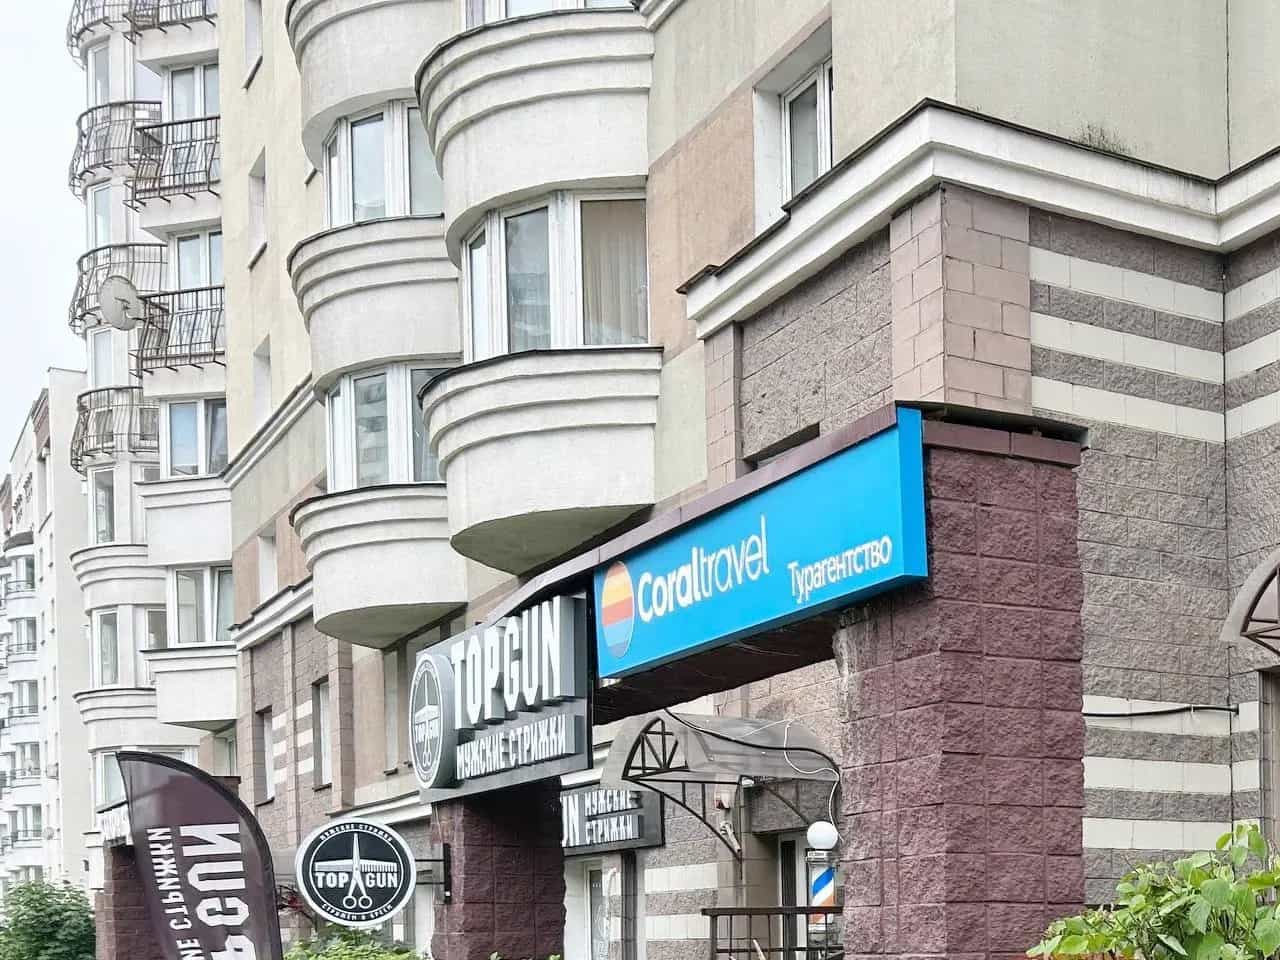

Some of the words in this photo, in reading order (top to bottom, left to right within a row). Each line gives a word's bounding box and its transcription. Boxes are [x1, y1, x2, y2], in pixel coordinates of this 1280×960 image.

[787, 535, 893, 604] Турагентство
[457, 731, 507, 780] МУЖСКИЕ
[509, 713, 566, 768] СТРИЖКИ
[584, 789, 632, 817] МУЖСКИЕ
[585, 815, 633, 845] СТРИЖКИ
[315, 871, 349, 888] TOP
[365, 871, 398, 888] GUN
